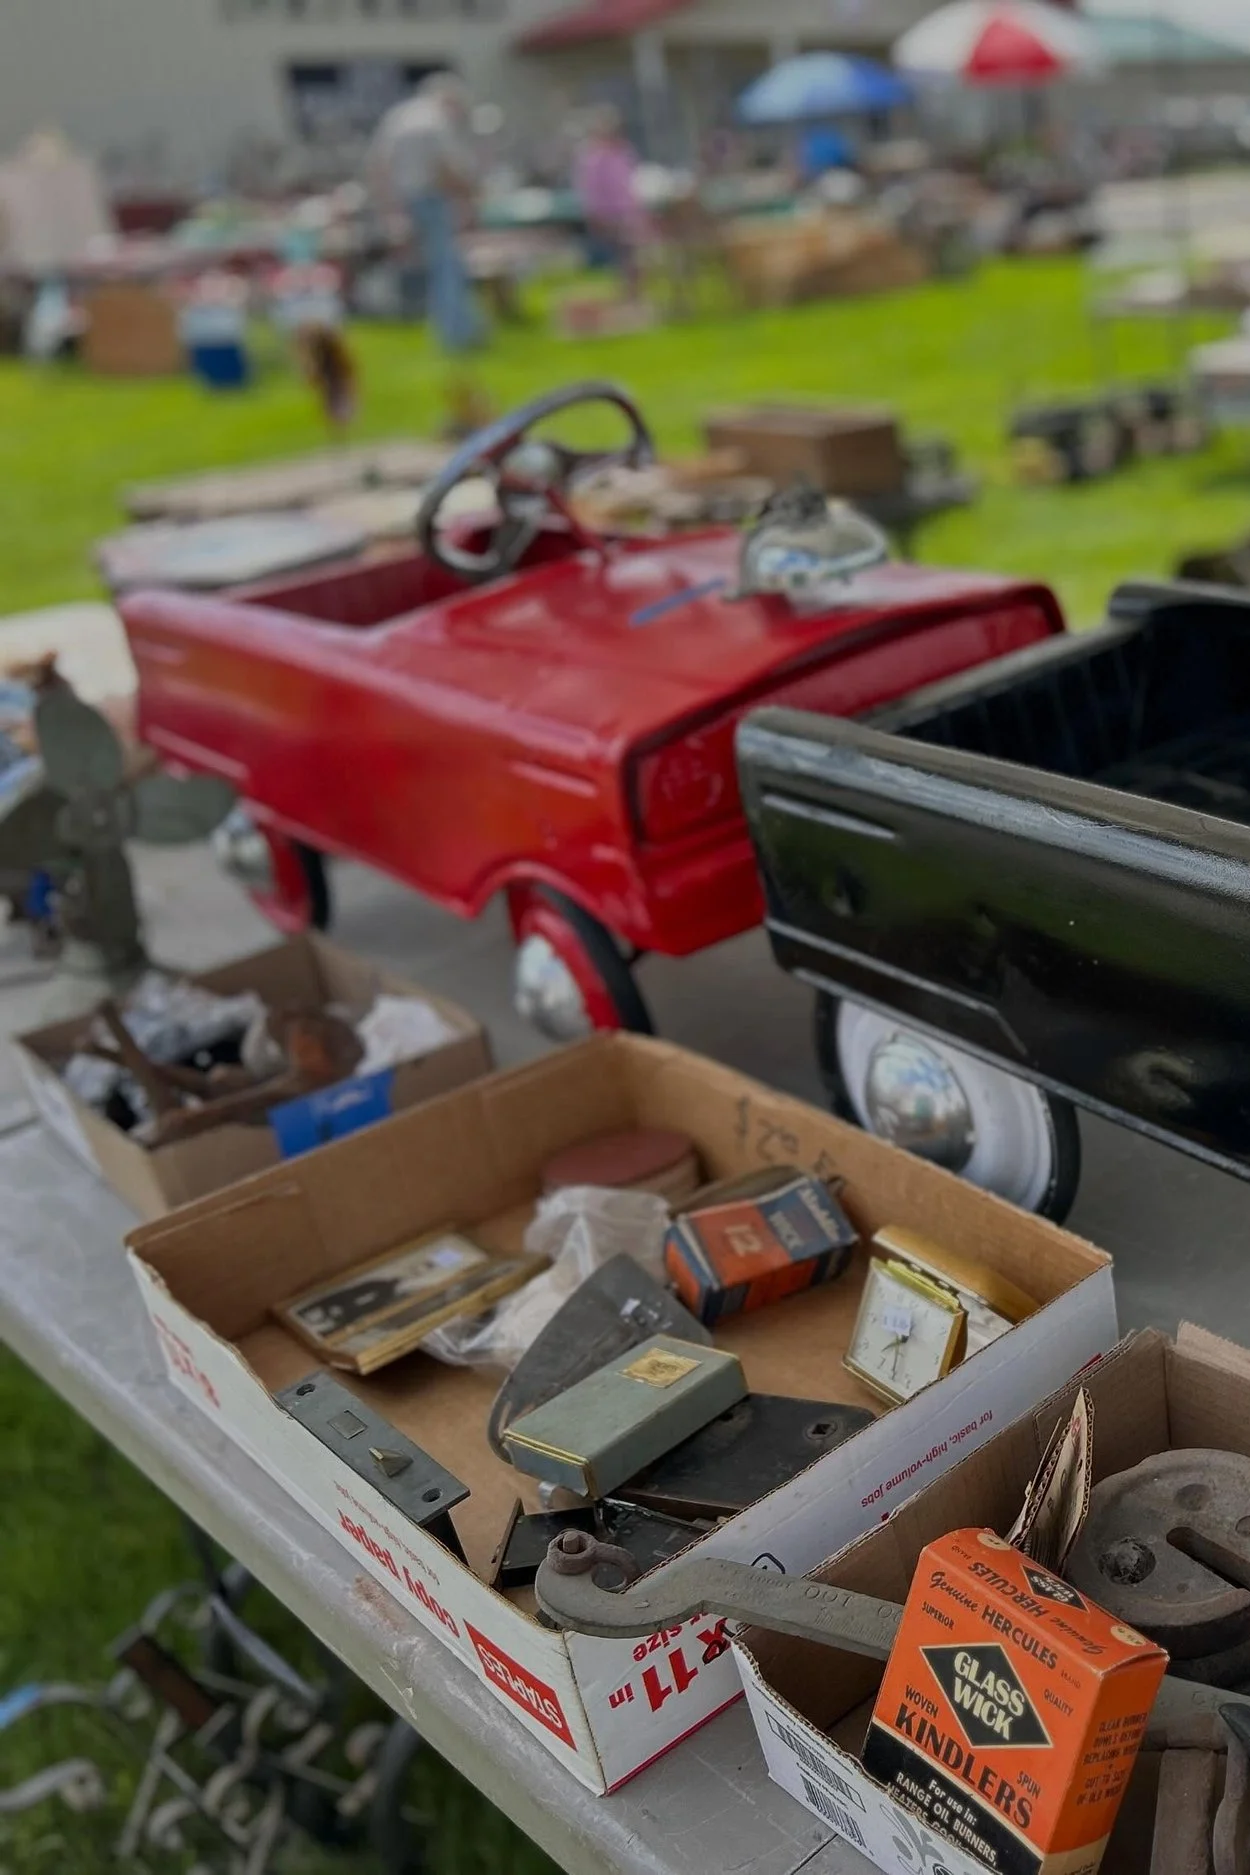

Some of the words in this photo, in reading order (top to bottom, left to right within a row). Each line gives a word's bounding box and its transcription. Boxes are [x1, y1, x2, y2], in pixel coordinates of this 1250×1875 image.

[949, 1421, 978, 1445] basic,
[979, 1409, 994, 1426] for
[885, 1441, 948, 1491] high-volume
[861, 1481, 885, 1508] jobs
[336, 1507, 402, 1582] paper
[402, 1564, 461, 1639] copy
[967, 1561, 1049, 1618] HERCULES
[1030, 1575, 1069, 1603] GLASS
[921, 1601, 955, 1631] SUPERIOR
[929, 1571, 978, 1612] Genuine
[981, 1604, 1058, 1670] HERCULES
[1050, 1615, 1104, 1655] Genuine
[632, 1624, 683, 1663] size
[476, 1642, 563, 1730] STAPLES
[608, 1682, 635, 1710] in
[641, 1647, 699, 1713] 11
[905, 1684, 939, 1718] WOVEN
[953, 1651, 1025, 1718] GLASS
[1043, 1687, 1074, 1718] QUALITY
[952, 1678, 1014, 1741] WICK
[895, 1703, 1034, 1830] KINDLERS
[1016, 1771, 1042, 1800] SPUN
[896, 1771, 933, 1807] RANGE
[933, 1802, 950, 1825] OIL
[952, 1818, 998, 1867] BURNERS,
[928, 1779, 946, 1798] For
[946, 1796, 963, 1815] use
[963, 1807, 978, 1827] in:
